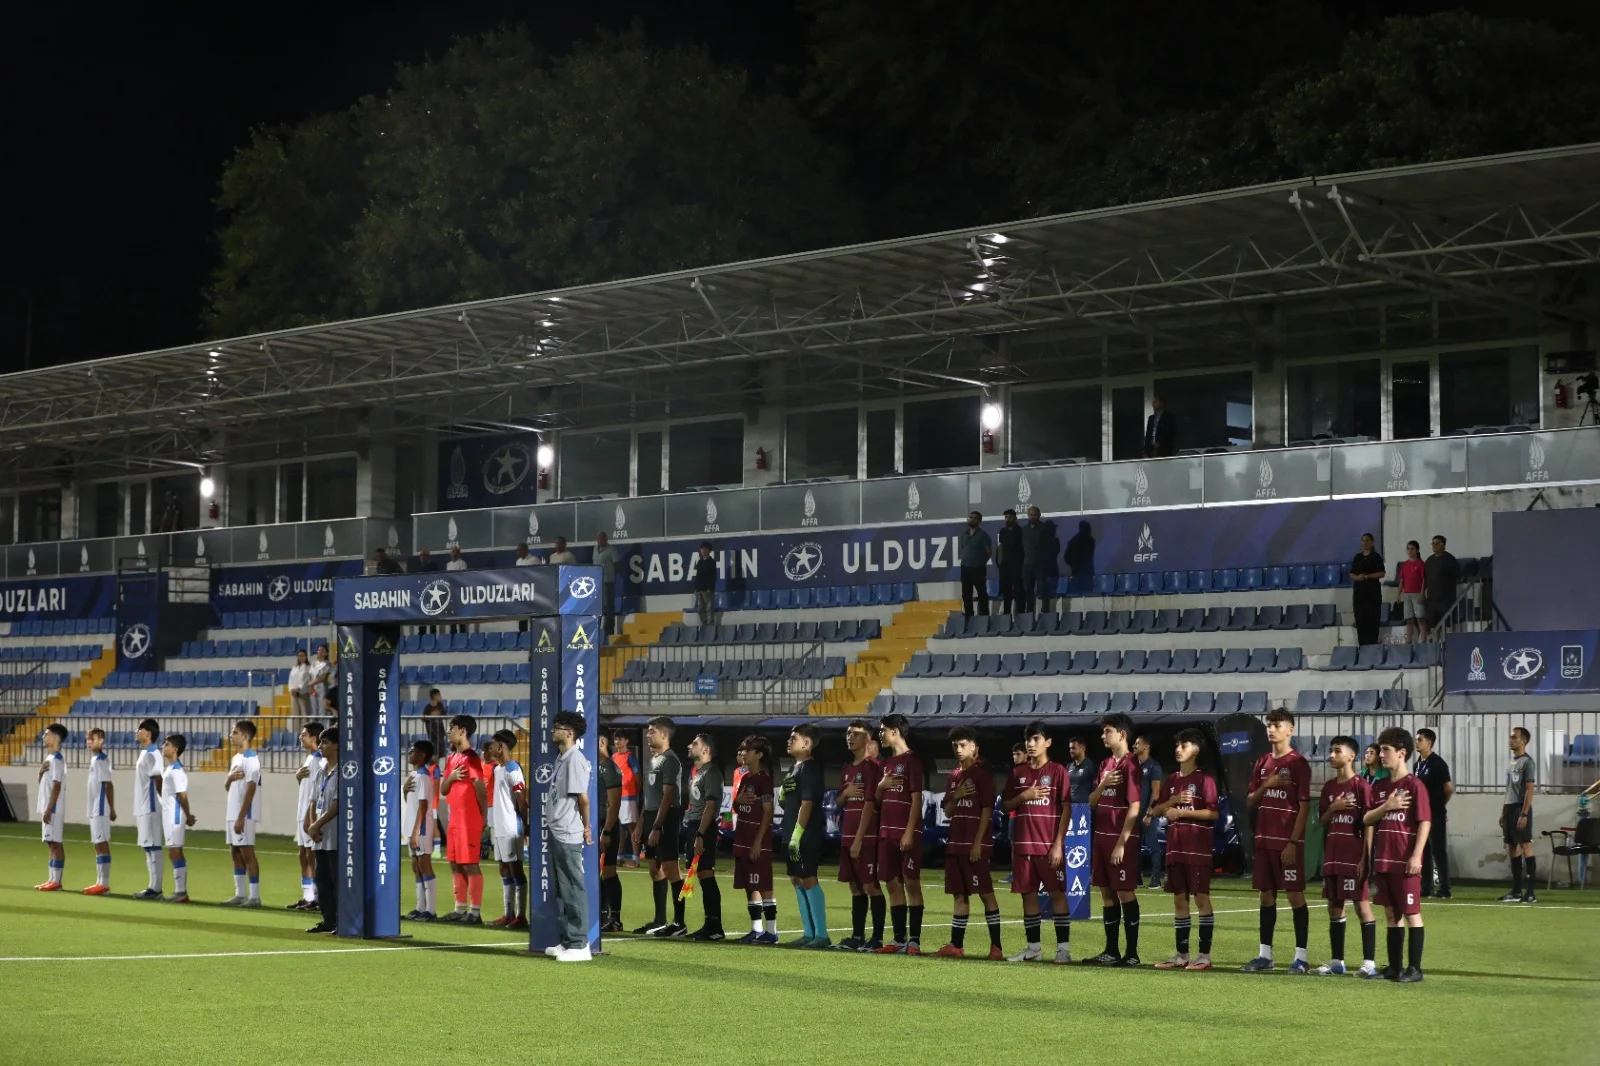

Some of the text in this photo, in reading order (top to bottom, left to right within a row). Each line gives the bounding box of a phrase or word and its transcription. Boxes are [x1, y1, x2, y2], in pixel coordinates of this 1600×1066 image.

[1526, 471, 1549, 481] AFFA
[1387, 480, 1409, 490] AFFA
[1256, 488, 1276, 498] AFFA
[1131, 496, 1152, 506] AFFA
[905, 510, 922, 520] AFFA
[802, 517, 818, 526] AFFA
[612, 529, 628, 539] AFFA
[704, 523, 719, 533] AFFA
[526, 535, 541, 545] AFFA
[1133, 552, 1158, 563] BFF
[218, 582, 264, 597] SABAHIN
[354, 589, 411, 610] SABAHIN
[460, 582, 535, 605] ULDUZLARI
[540, 667, 549, 754] SABAHIN
[575, 663, 585, 750] SABAN
[346, 672, 354, 888] SABAHIN ULDUZLARI
[377, 668, 388, 885] SABAHIN ULDUZLARI
[867, 863, 874, 875] 7
[1119, 869, 1126, 881] 3
[749, 873, 760, 884] 10
[972, 875, 979, 887] 5
[1284, 869, 1297, 882] 55
[1343, 878, 1355, 891] 20
[1407, 893, 1414, 905] 6
